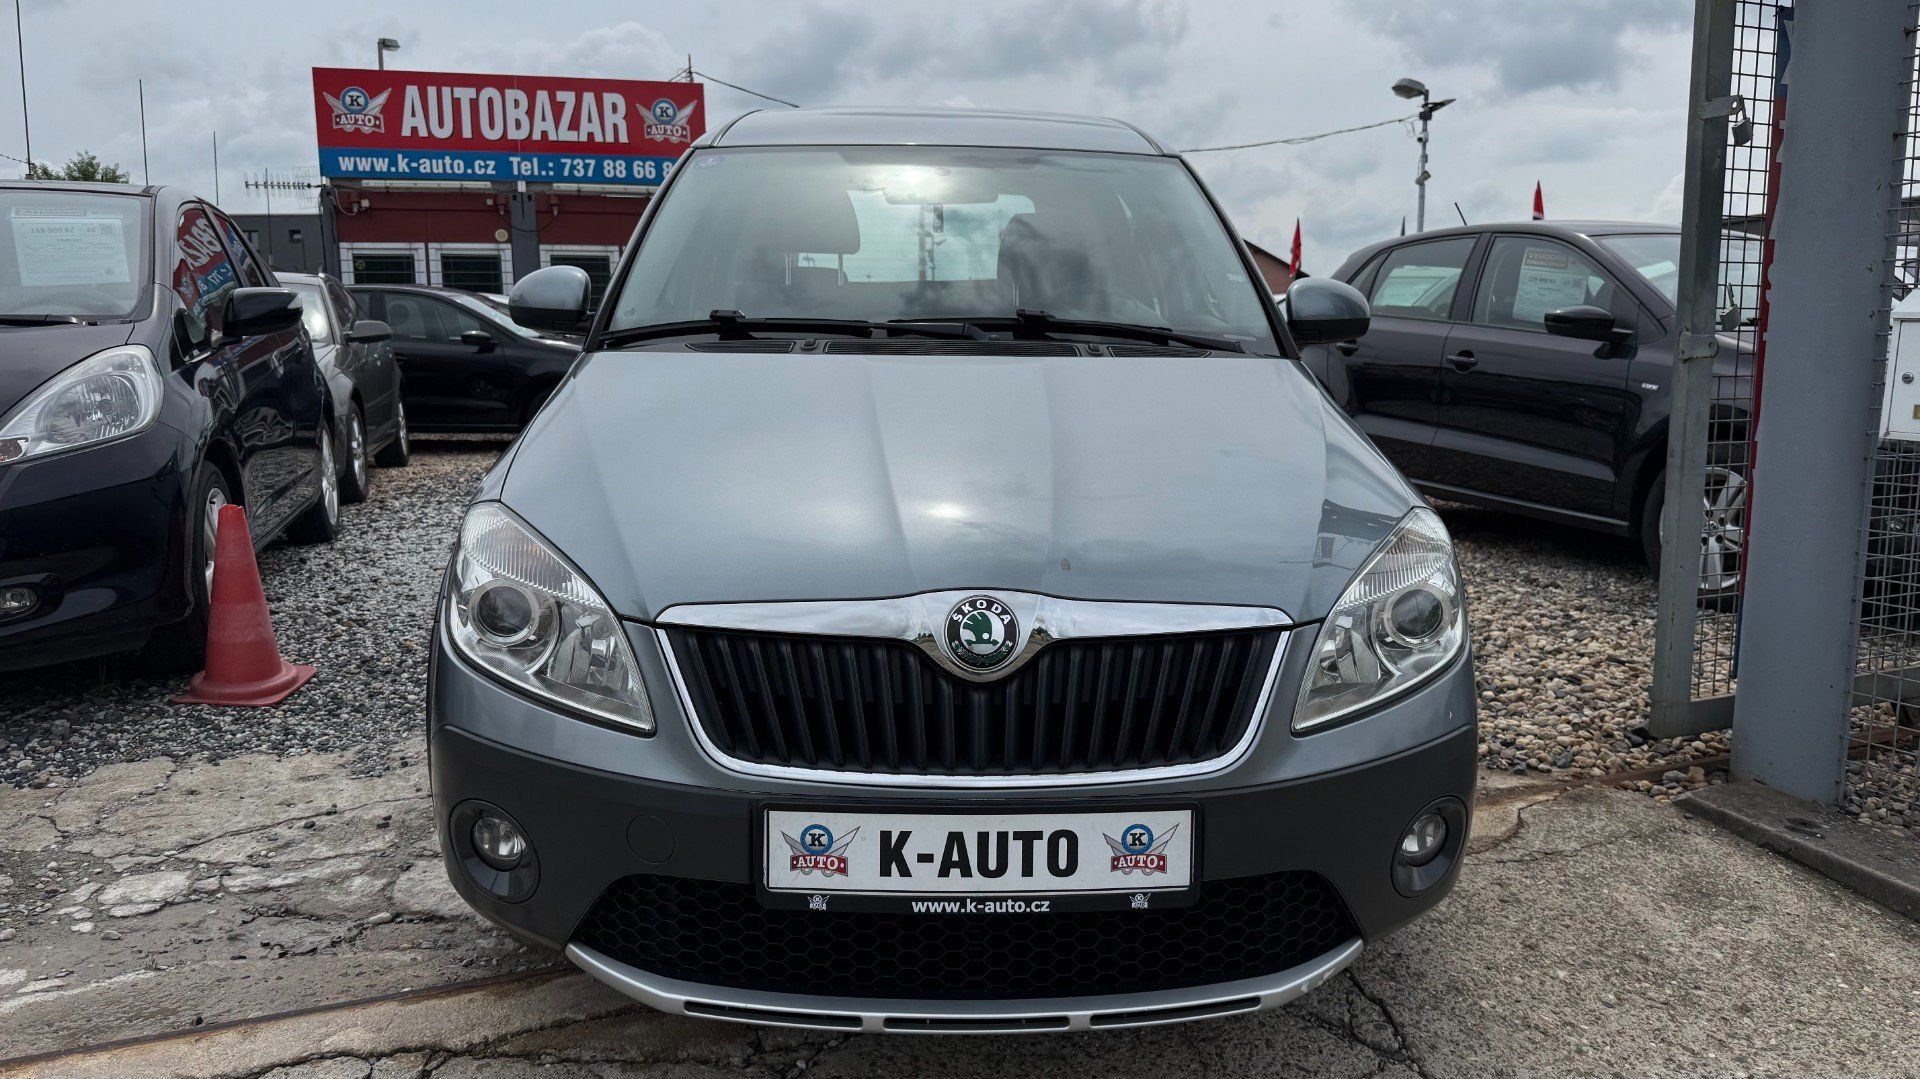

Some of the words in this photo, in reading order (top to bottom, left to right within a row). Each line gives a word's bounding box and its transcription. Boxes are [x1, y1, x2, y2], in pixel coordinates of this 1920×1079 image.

[347, 94, 363, 107] K
[401, 85, 630, 144] AUTOBAZAR
[658, 106, 671, 118] K
[340, 114, 375, 127] AUTO
[650, 124, 683, 137] AUTO
[338, 154, 496, 175] www.k-auto.cz
[509, 156, 554, 176] Tel.:
[560, 158, 596, 178] 737
[603, 159, 627, 179] 88
[633, 160, 657, 179] 66
[808, 832, 826, 847] K
[1128, 832, 1147, 847] K
[878, 829, 1080, 879] K-AUTO
[797, 856, 839, 870] AUTO
[1117, 855, 1159, 869] AUTO
[911, 898, 1051, 913] www.k-auto.cz
